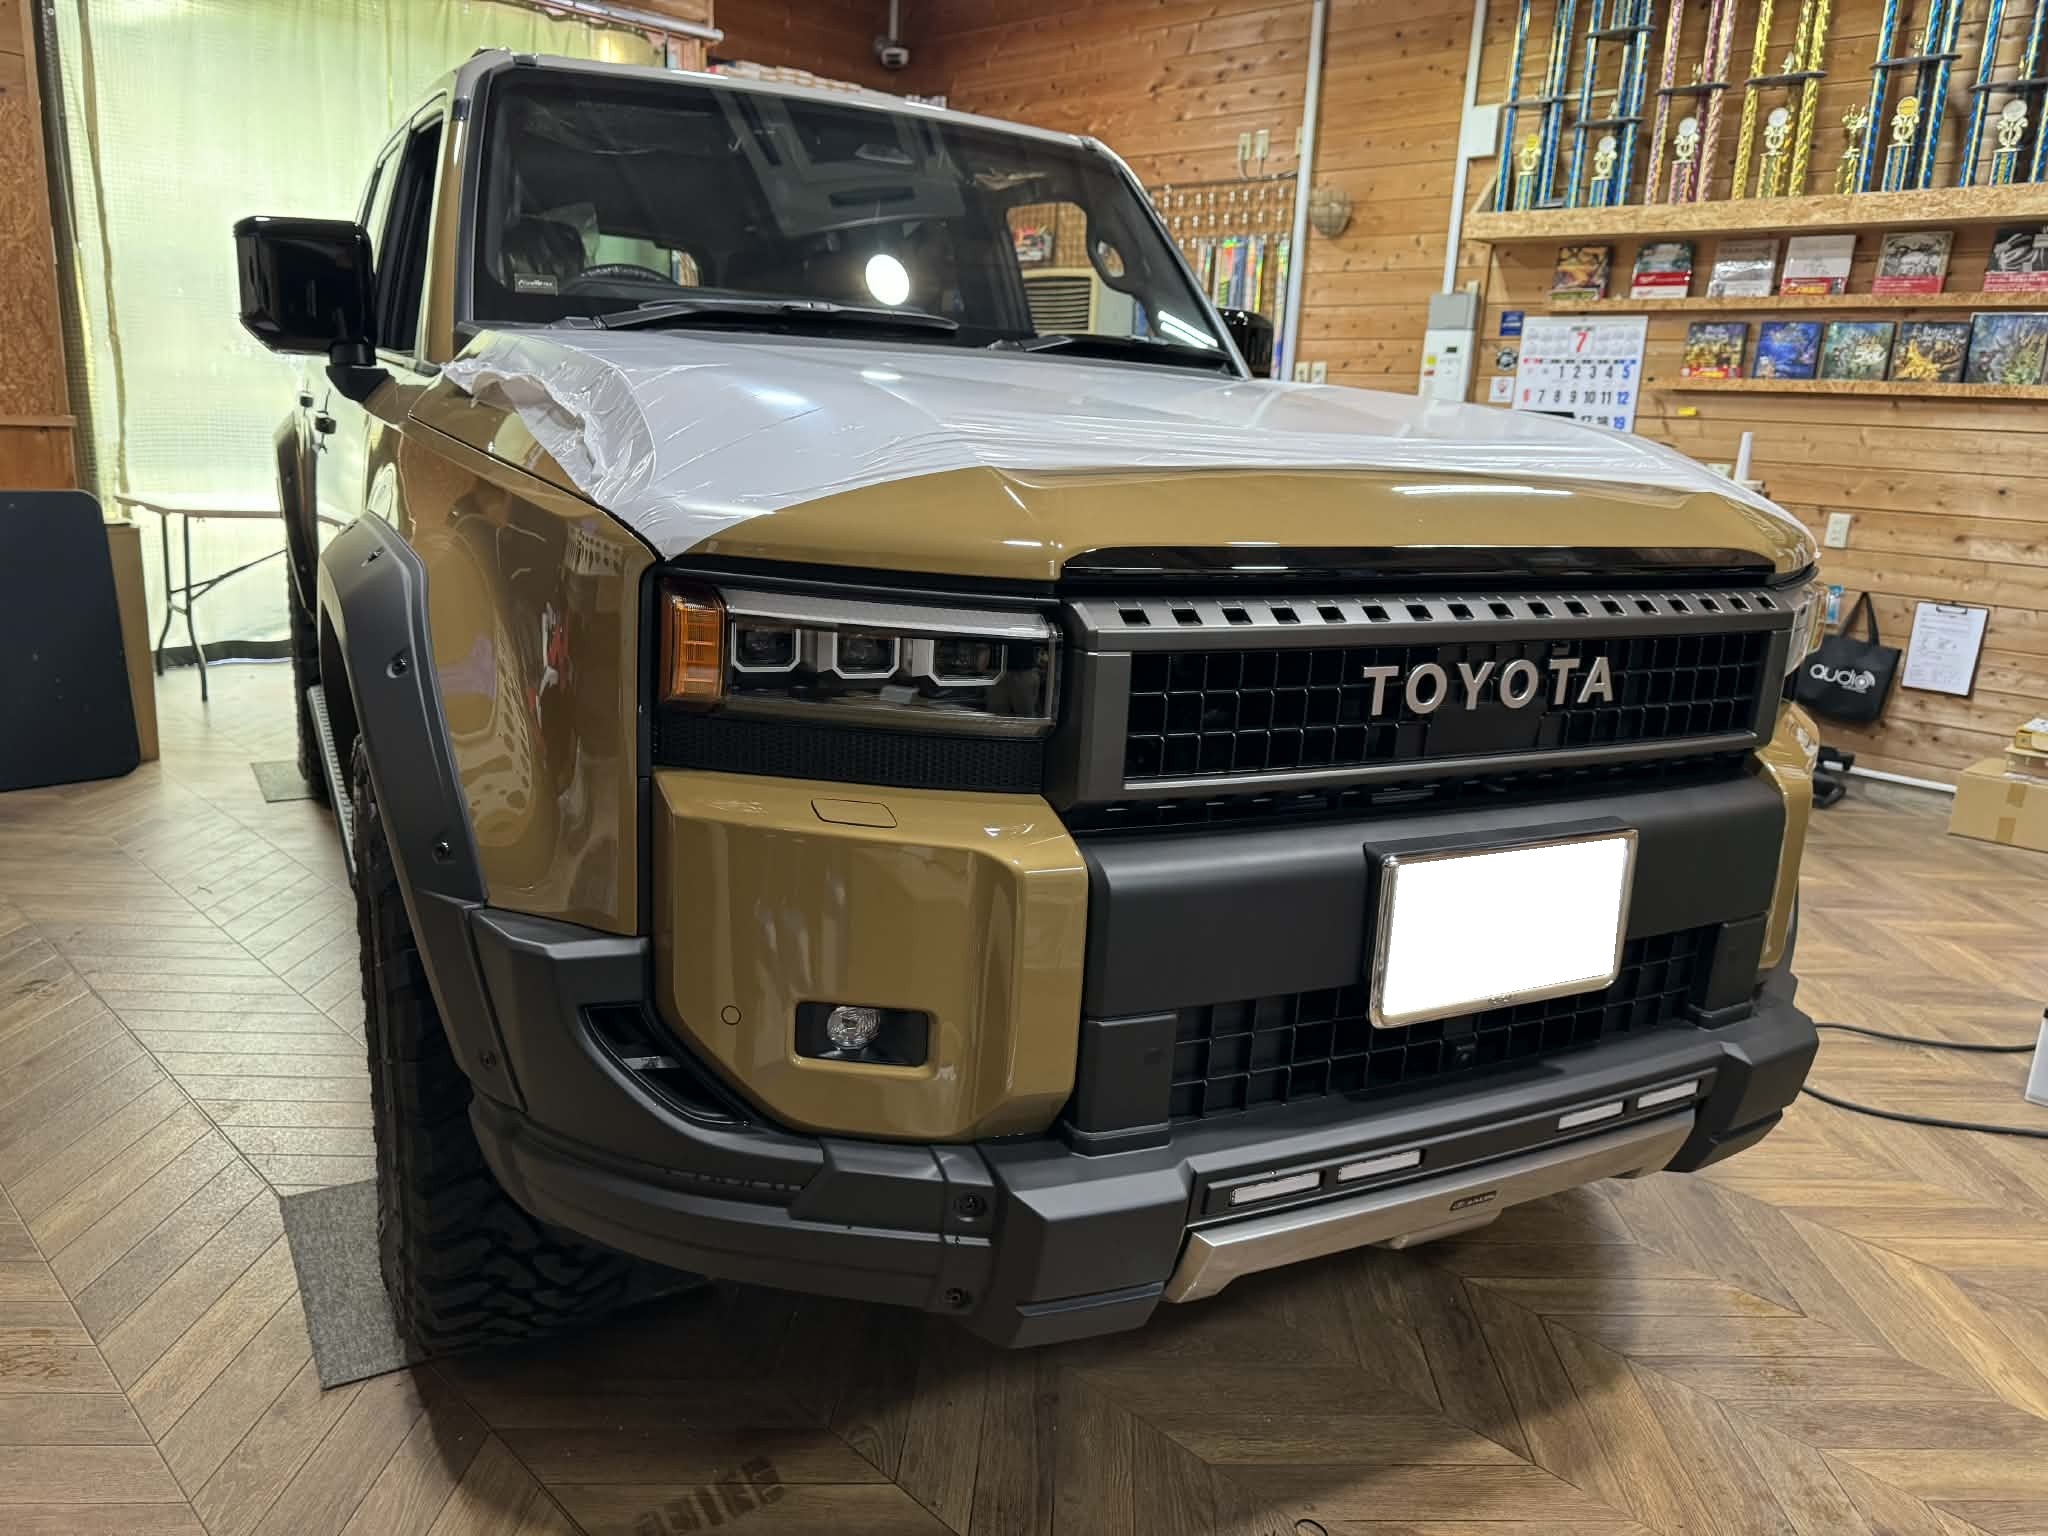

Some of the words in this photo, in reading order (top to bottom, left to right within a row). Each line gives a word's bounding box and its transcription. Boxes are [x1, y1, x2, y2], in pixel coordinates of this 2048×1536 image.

[1576, 331, 1588, 353] 7
[1573, 365, 1581, 379] 2
[1589, 365, 1597, 379] 3
[1605, 365, 1613, 379] 4
[1622, 364, 1630, 379] 5
[1538, 389, 1545, 403] 7
[1554, 389, 1561, 403] 8
[1570, 390, 1577, 403] 9
[1584, 391, 1597, 404] 10
[1601, 391, 1612, 405] 11
[1617, 391, 1630, 405] 12
[1363, 656, 1614, 716] TOYOTA
